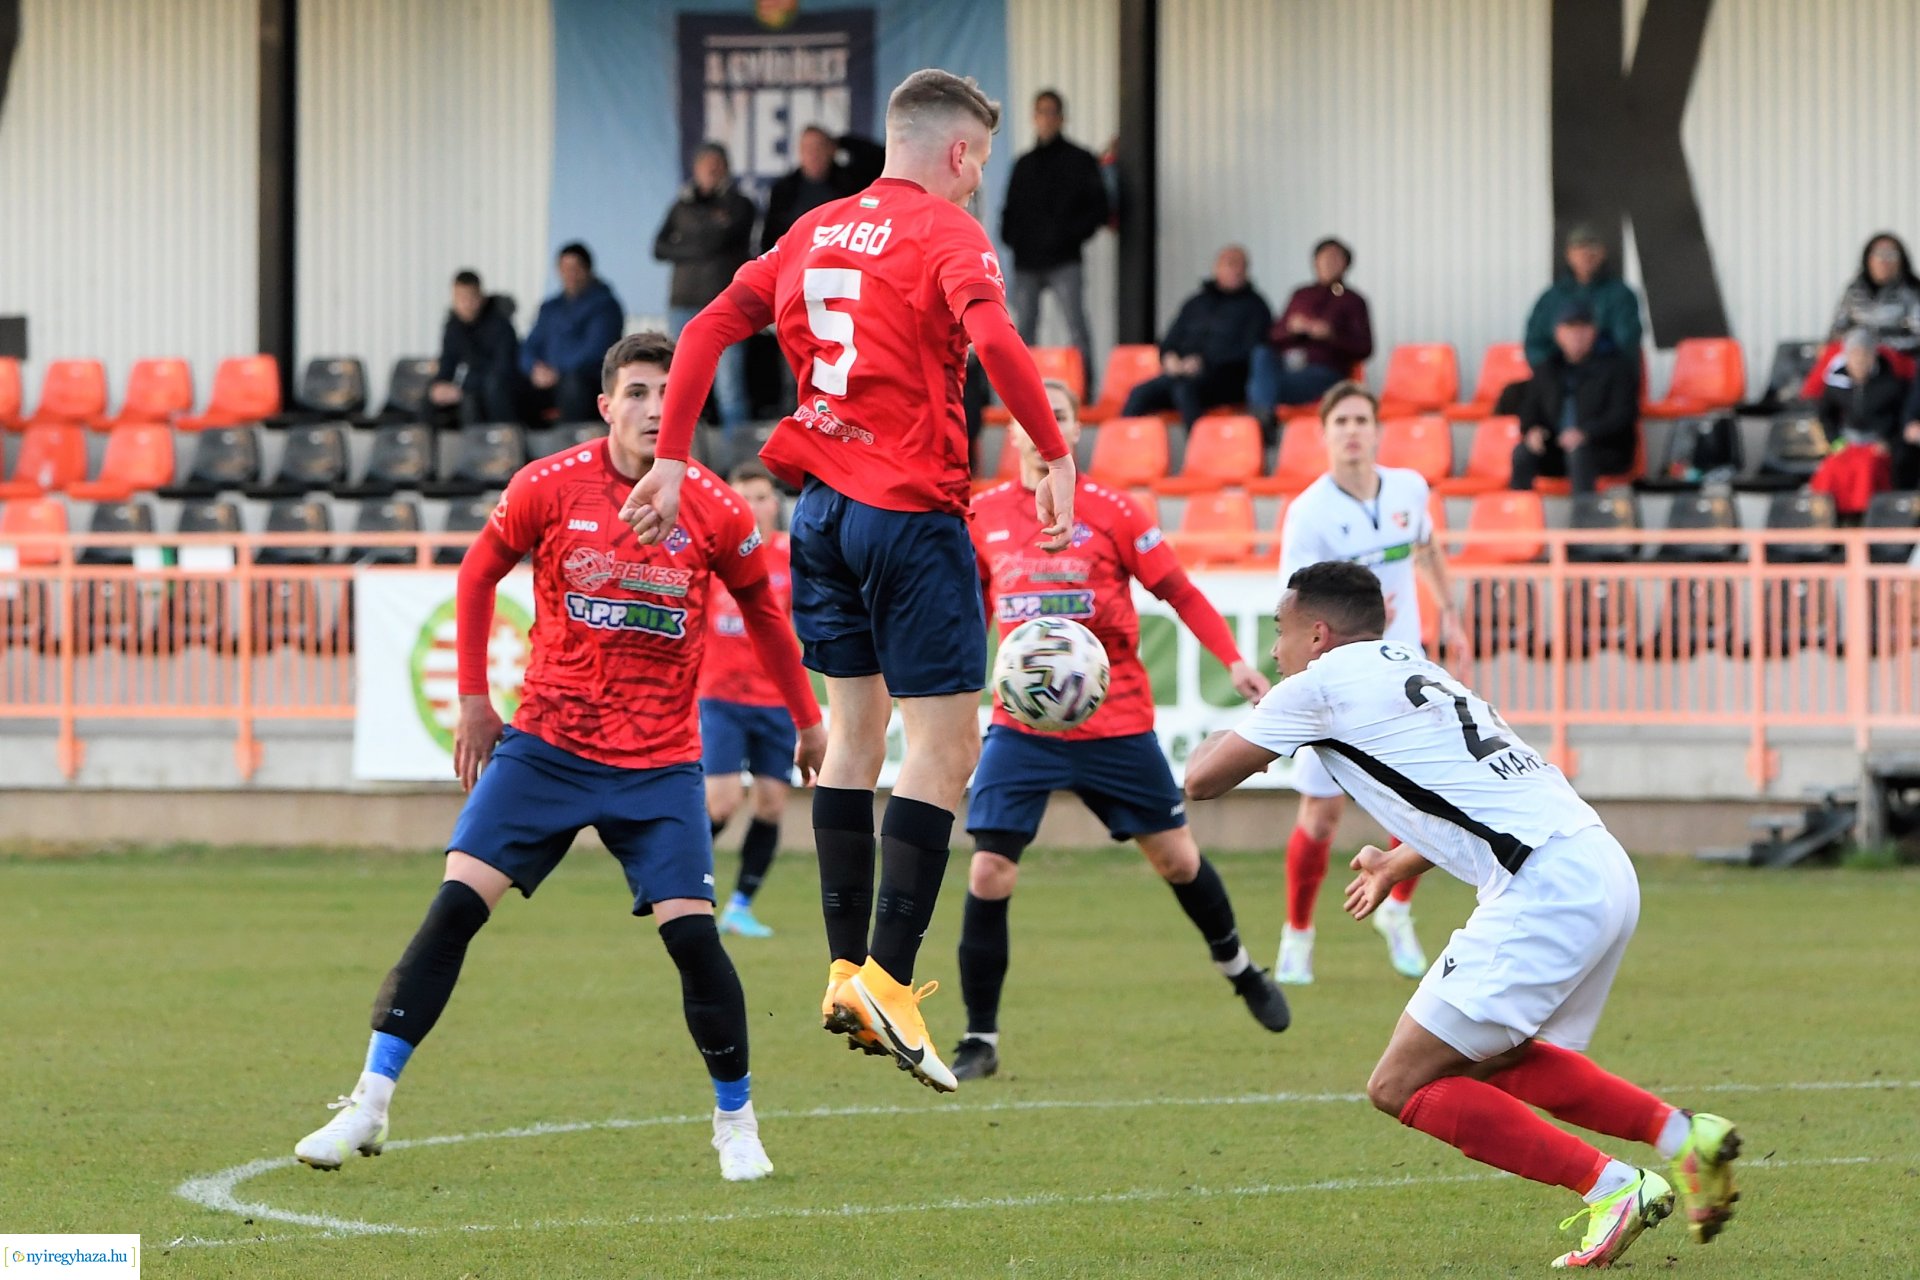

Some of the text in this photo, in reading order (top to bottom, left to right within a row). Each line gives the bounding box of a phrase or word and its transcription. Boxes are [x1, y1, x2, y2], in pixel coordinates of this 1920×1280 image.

[809, 218, 892, 256] SZABÓ
[803, 267, 862, 396] 5
[567, 518, 599, 532] JAKO
